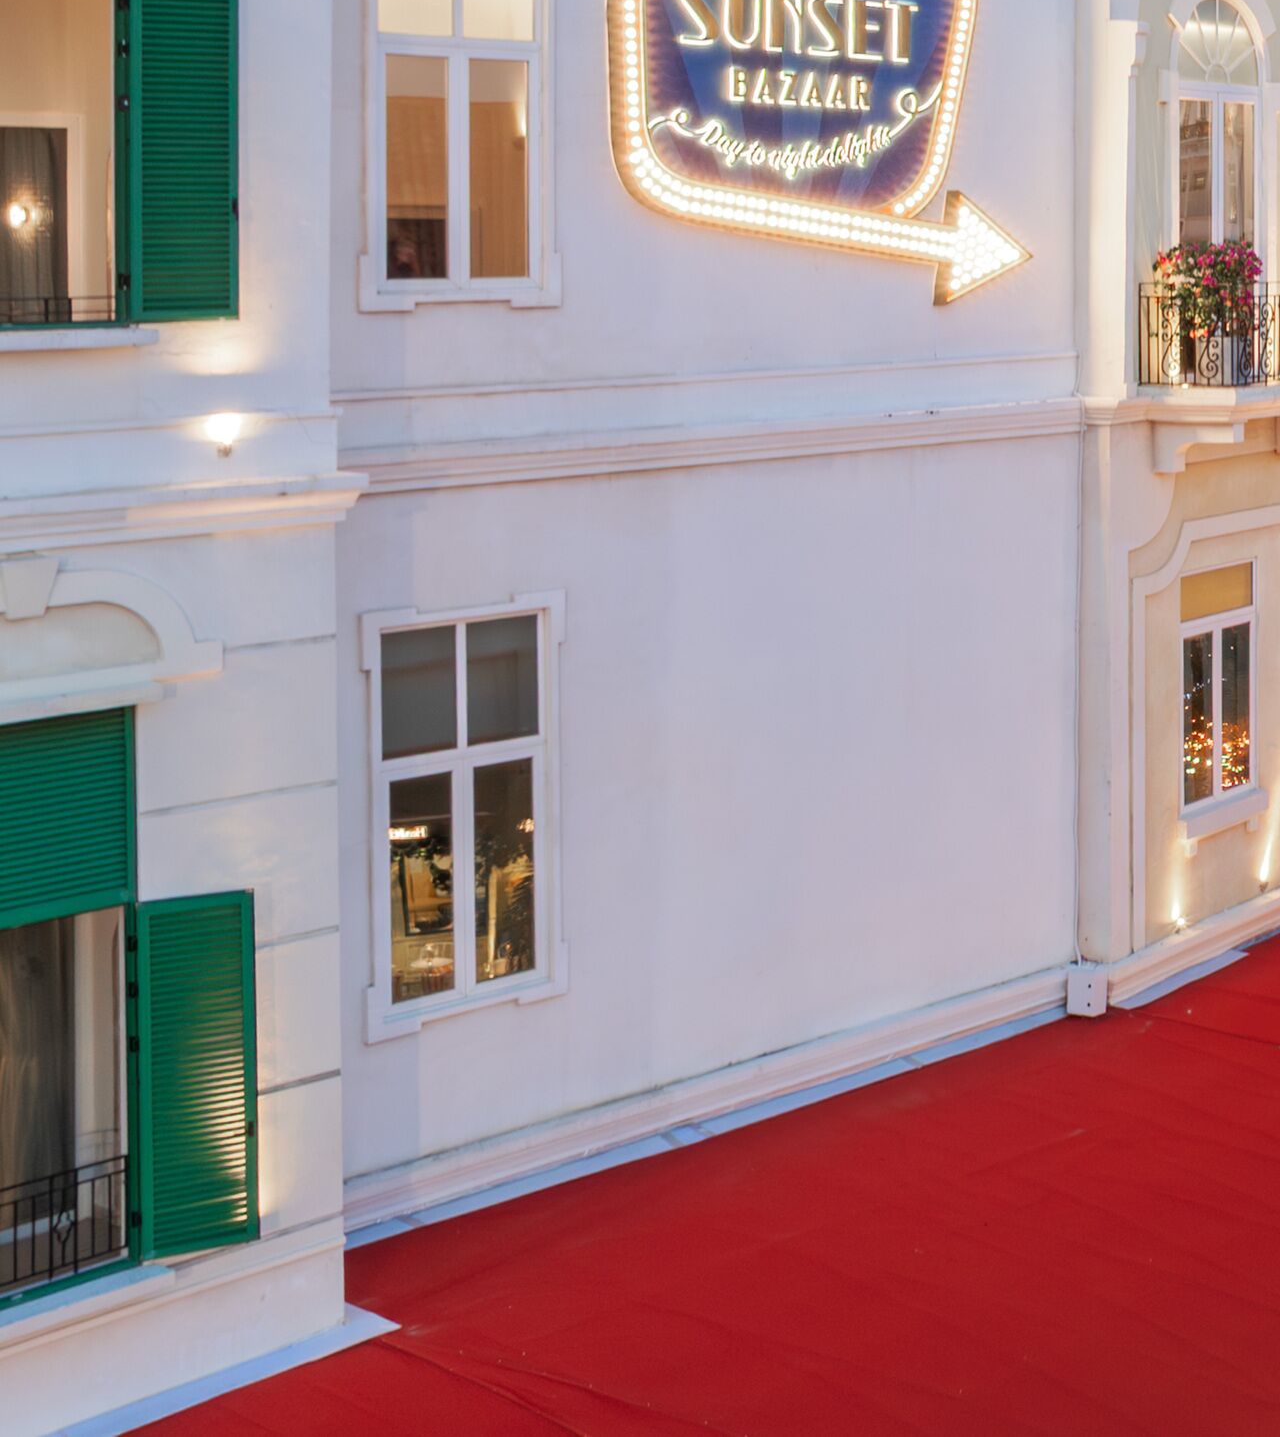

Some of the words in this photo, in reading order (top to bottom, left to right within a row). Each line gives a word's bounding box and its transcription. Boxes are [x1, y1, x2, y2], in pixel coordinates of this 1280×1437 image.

[727, 65, 871, 111] BAZAAR
[700, 119, 745, 167] Day
[746, 140, 766, 166] to
